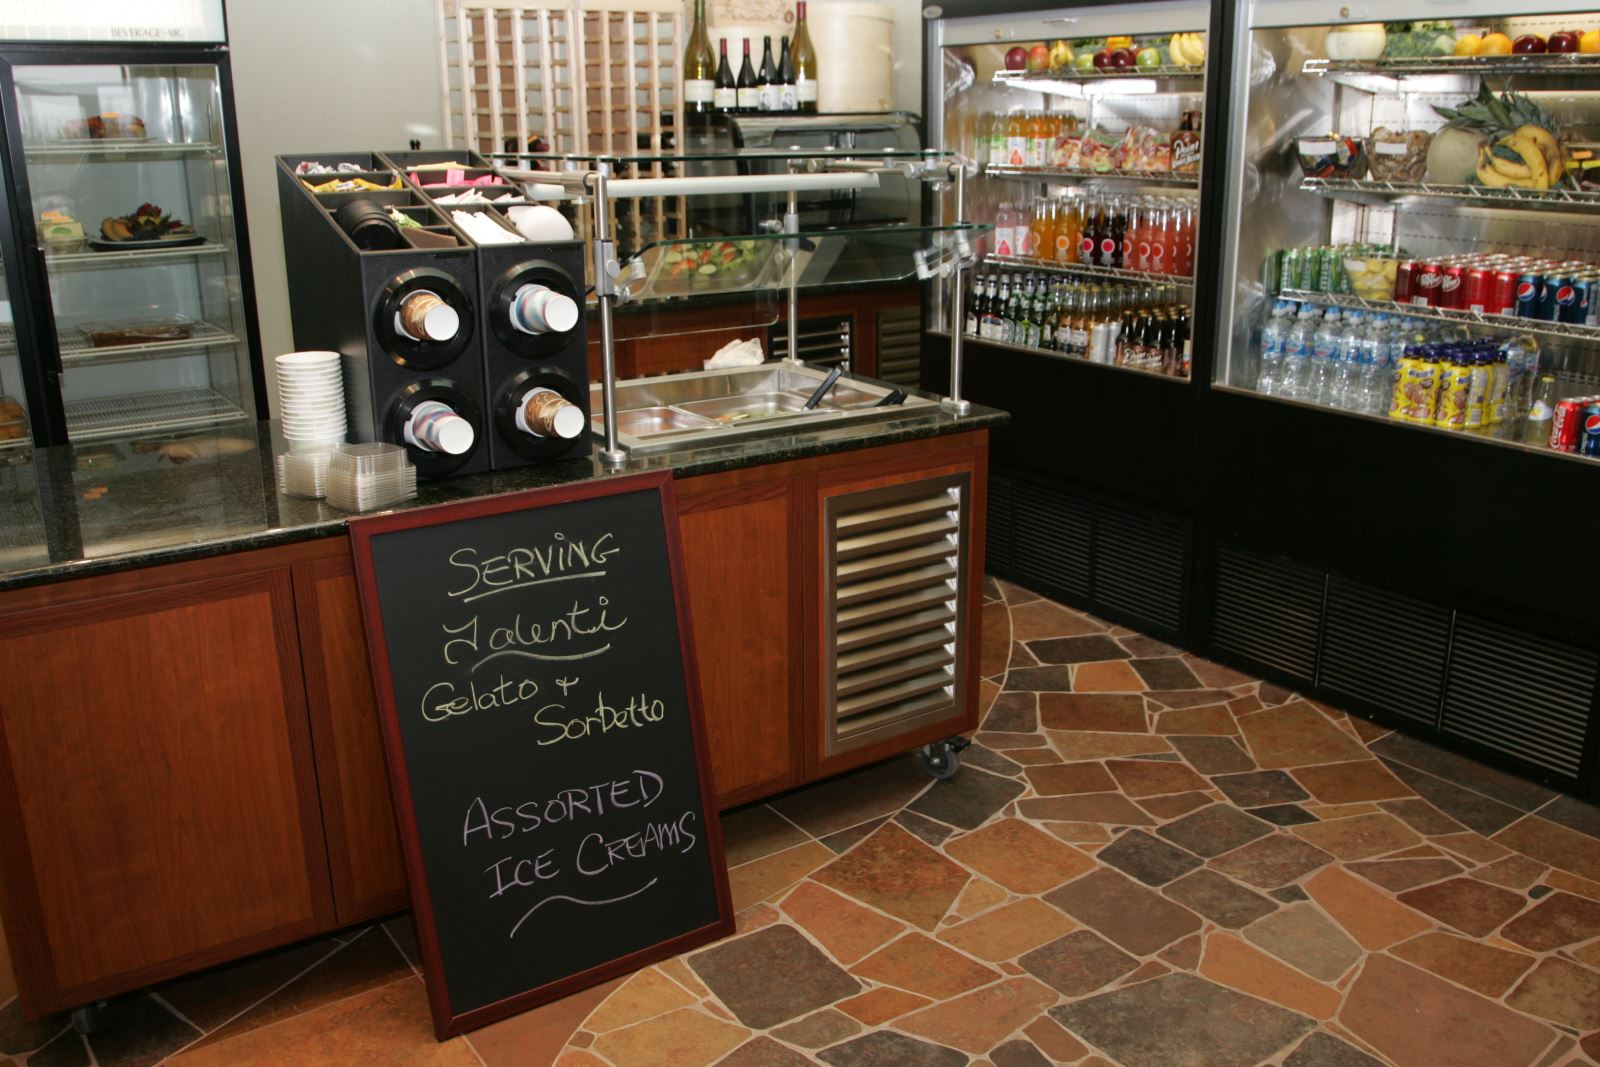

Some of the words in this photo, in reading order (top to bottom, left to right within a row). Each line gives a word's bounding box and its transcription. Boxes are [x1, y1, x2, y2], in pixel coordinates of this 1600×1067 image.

[421, 675, 540, 723] Gelato
[533, 692, 666, 746] Sorbetto
[463, 769, 665, 847] ASSORTED
[486, 848, 561, 900] ICE
